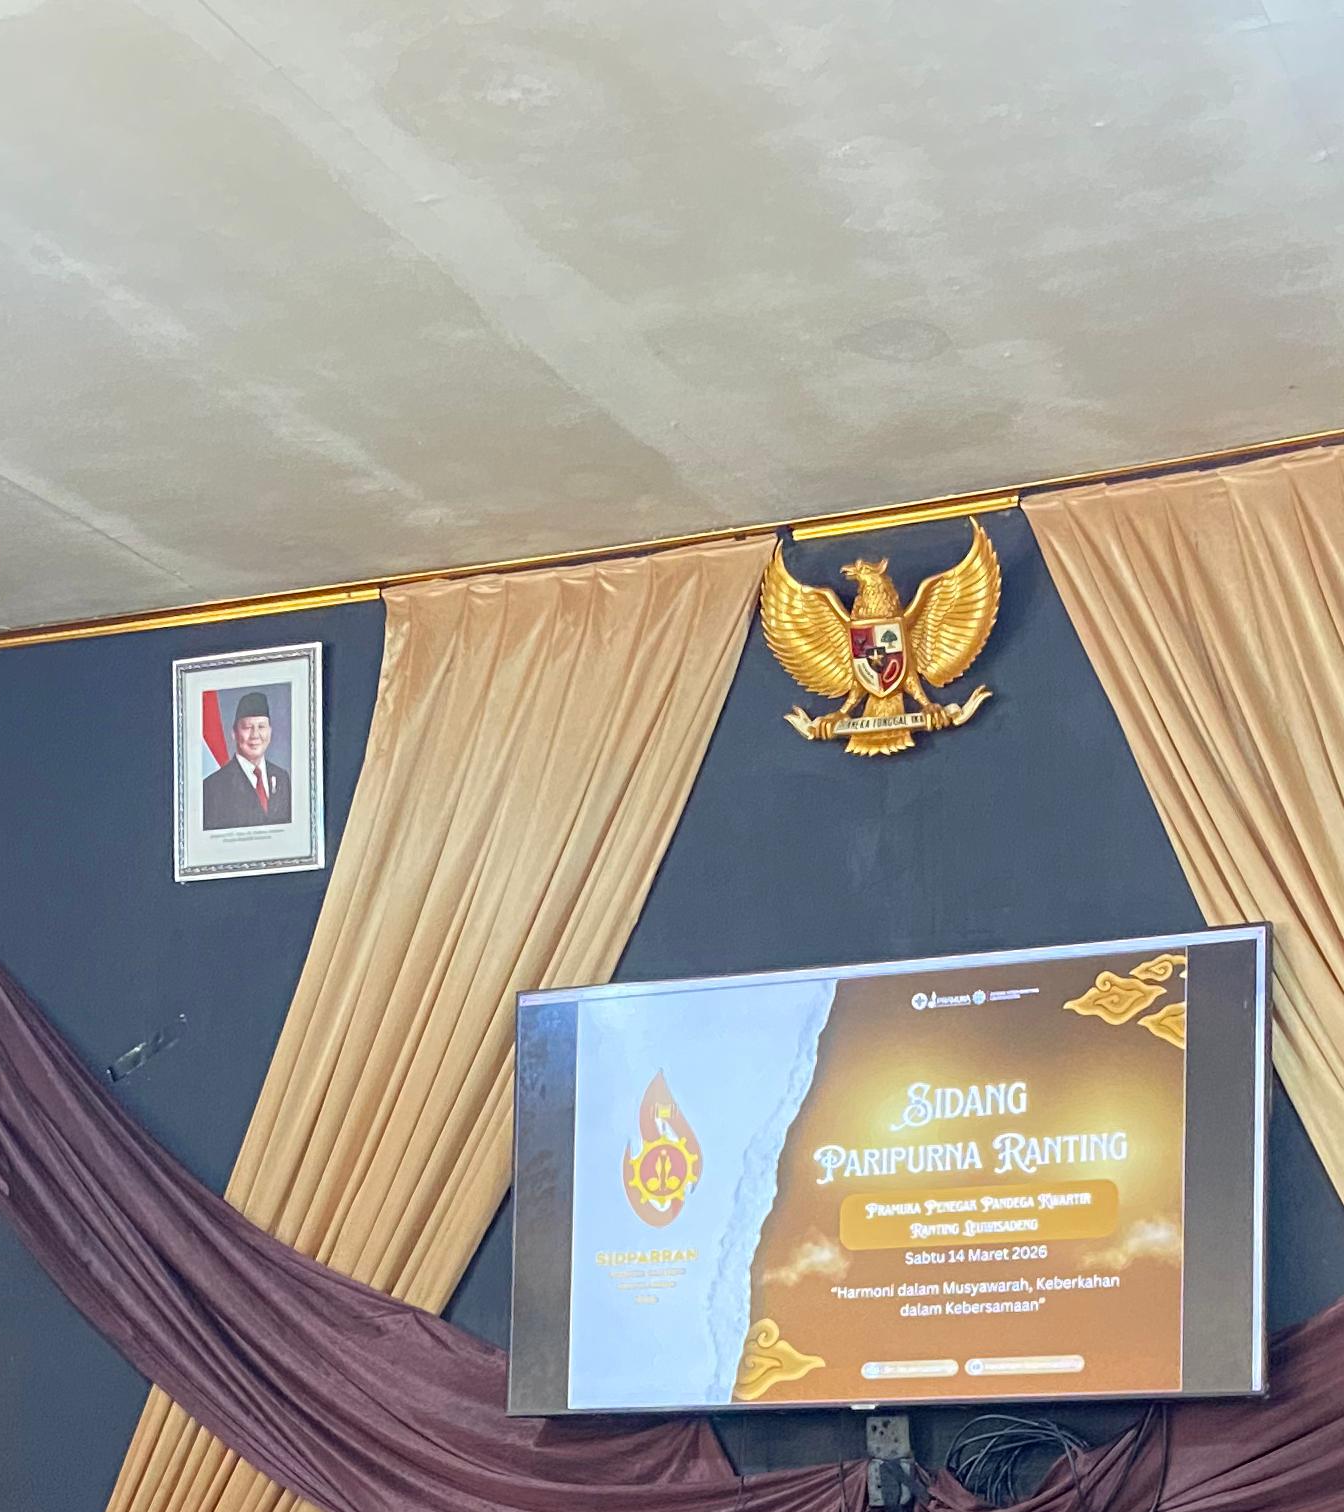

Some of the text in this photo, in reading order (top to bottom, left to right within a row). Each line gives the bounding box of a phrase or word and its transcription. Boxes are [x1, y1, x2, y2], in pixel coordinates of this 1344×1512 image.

[813, 1132, 1128, 1185] PARIPURNA RANTING
[905, 1245, 1048, 1265] Sabtu 14 Maret 2026
[898, 1282, 940, 1297] dalam
[943, 1278, 1033, 1296] Musyawarah,
[1036, 1274, 1120, 1291] Keberkahan
[900, 1302, 942, 1317] dalam
